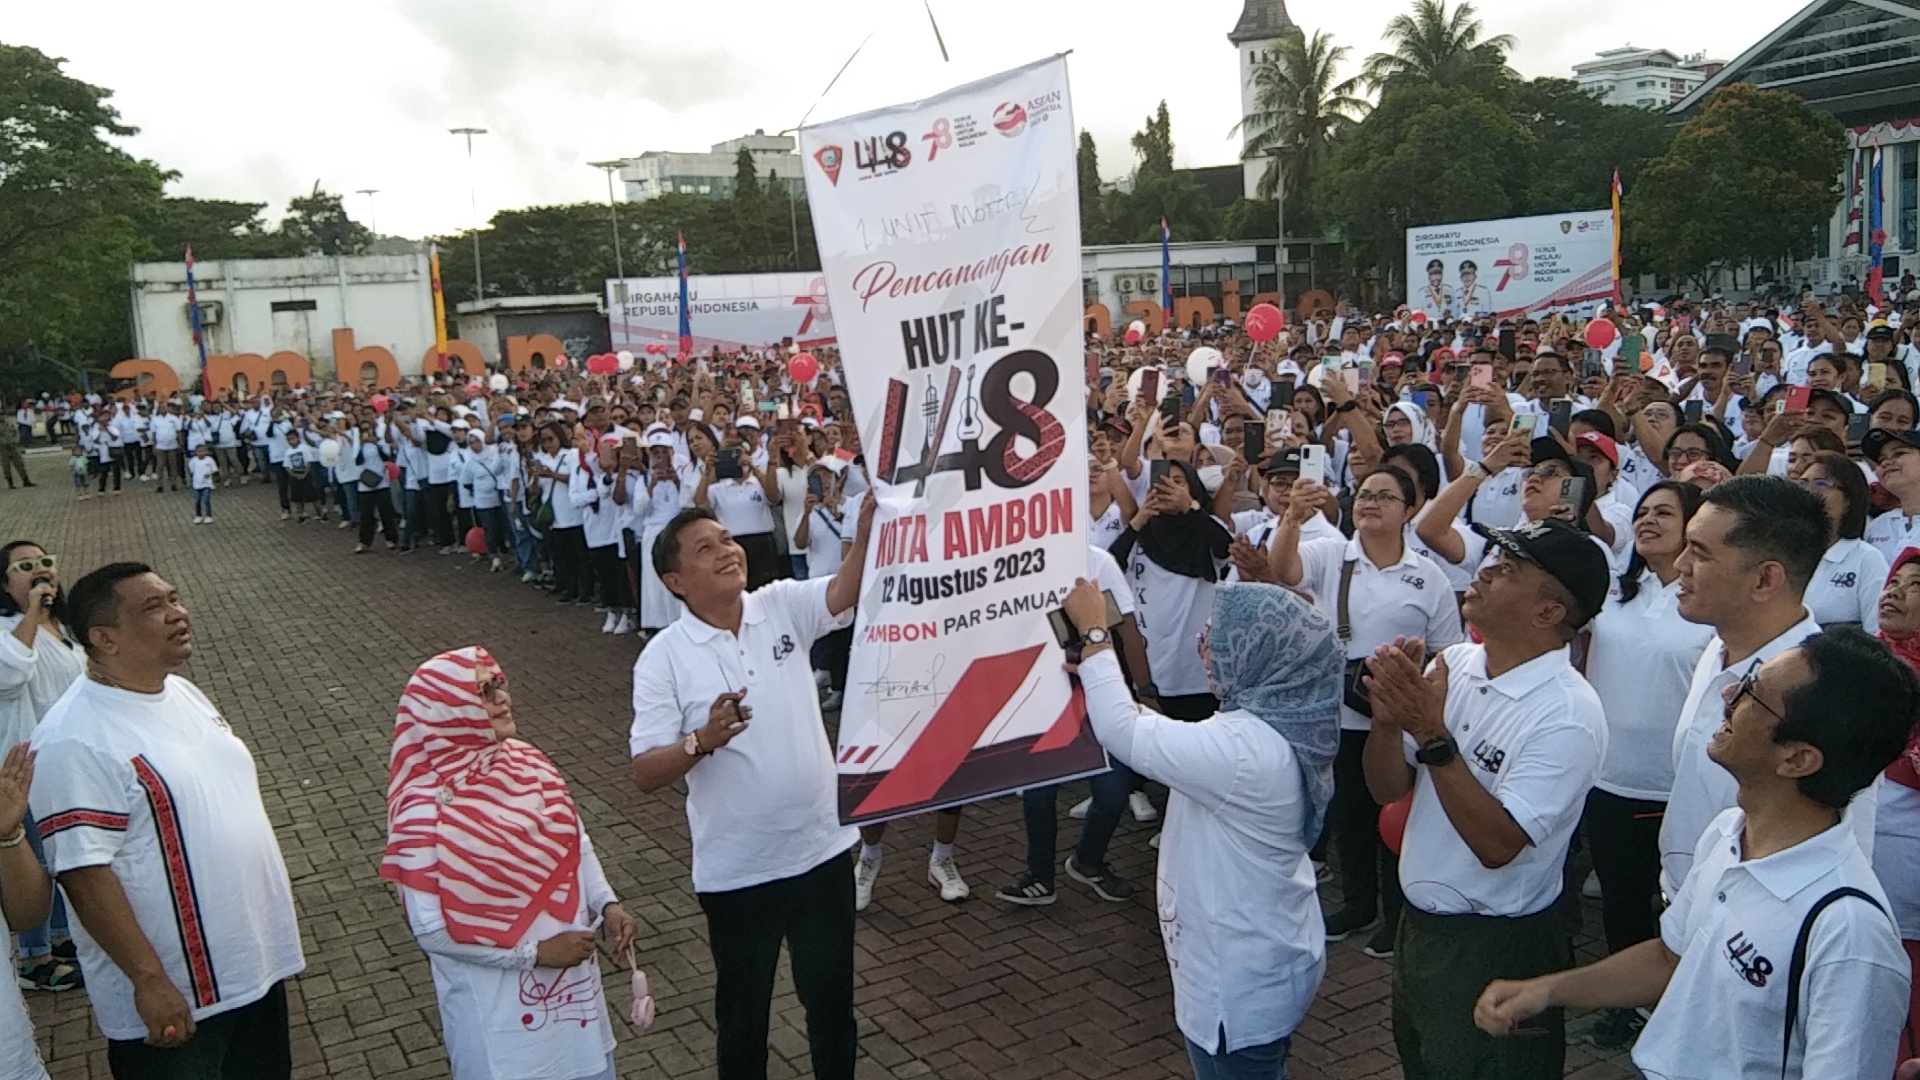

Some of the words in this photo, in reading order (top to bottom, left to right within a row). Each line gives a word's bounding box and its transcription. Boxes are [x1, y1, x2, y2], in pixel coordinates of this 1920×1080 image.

[1027, 91, 1061, 111] ASEAN
[1415, 231, 1461, 242] DIRGAHAYU
[1415, 240, 1454, 250] REPUBLIK
[1454, 236, 1500, 248] INDONESIA
[853, 242, 1053, 313] Pencanangan
[1493, 243, 1529, 292] 78
[626, 290, 698, 303] IRGAHAU
[624, 305, 682, 317] REPUBLI
[901, 309, 965, 371] HUT
[974, 295, 1025, 354] KE-
[875, 514, 929, 569] KOTA
[943, 487, 1073, 561] AMBON
[882, 575, 895, 604] 12
[897, 566, 988, 605] Agustus
[994, 548, 1046, 582] 2023
[944, 609, 981, 636] PAR
